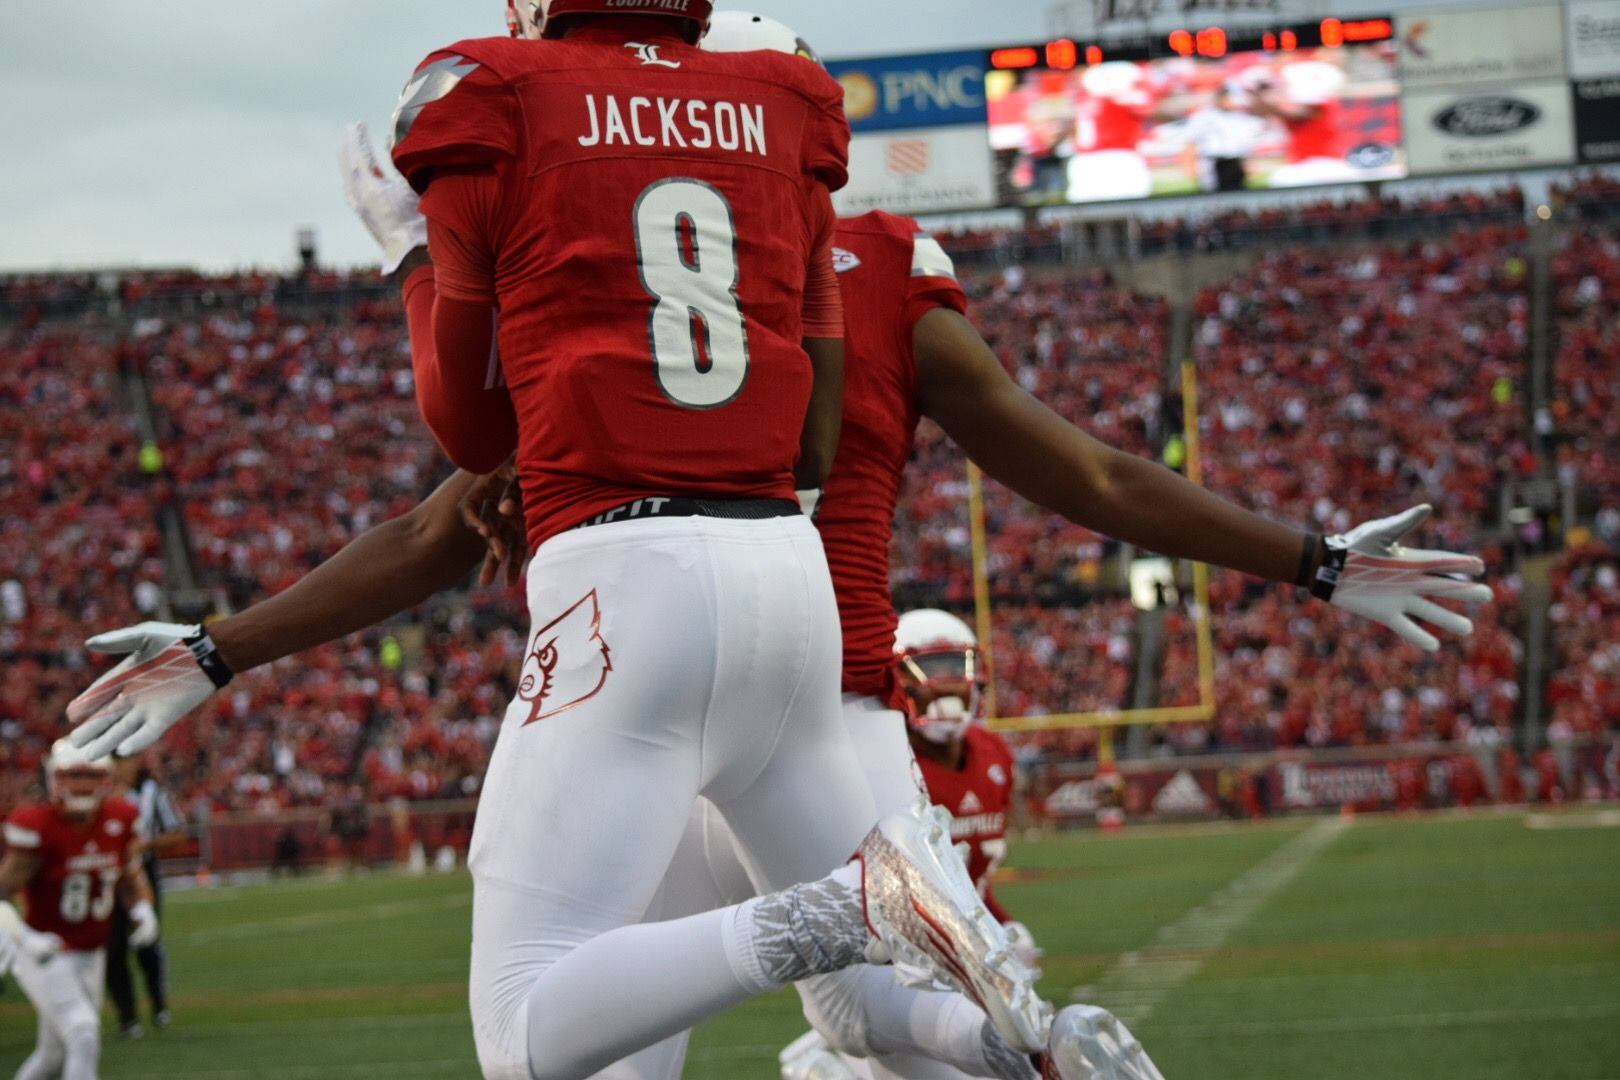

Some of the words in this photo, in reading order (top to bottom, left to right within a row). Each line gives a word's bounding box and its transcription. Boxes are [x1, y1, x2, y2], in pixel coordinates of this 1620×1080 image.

[880, 65, 986, 115] PNC
[578, 94, 767, 156] JACKSON
[632, 176, 750, 410] 8
